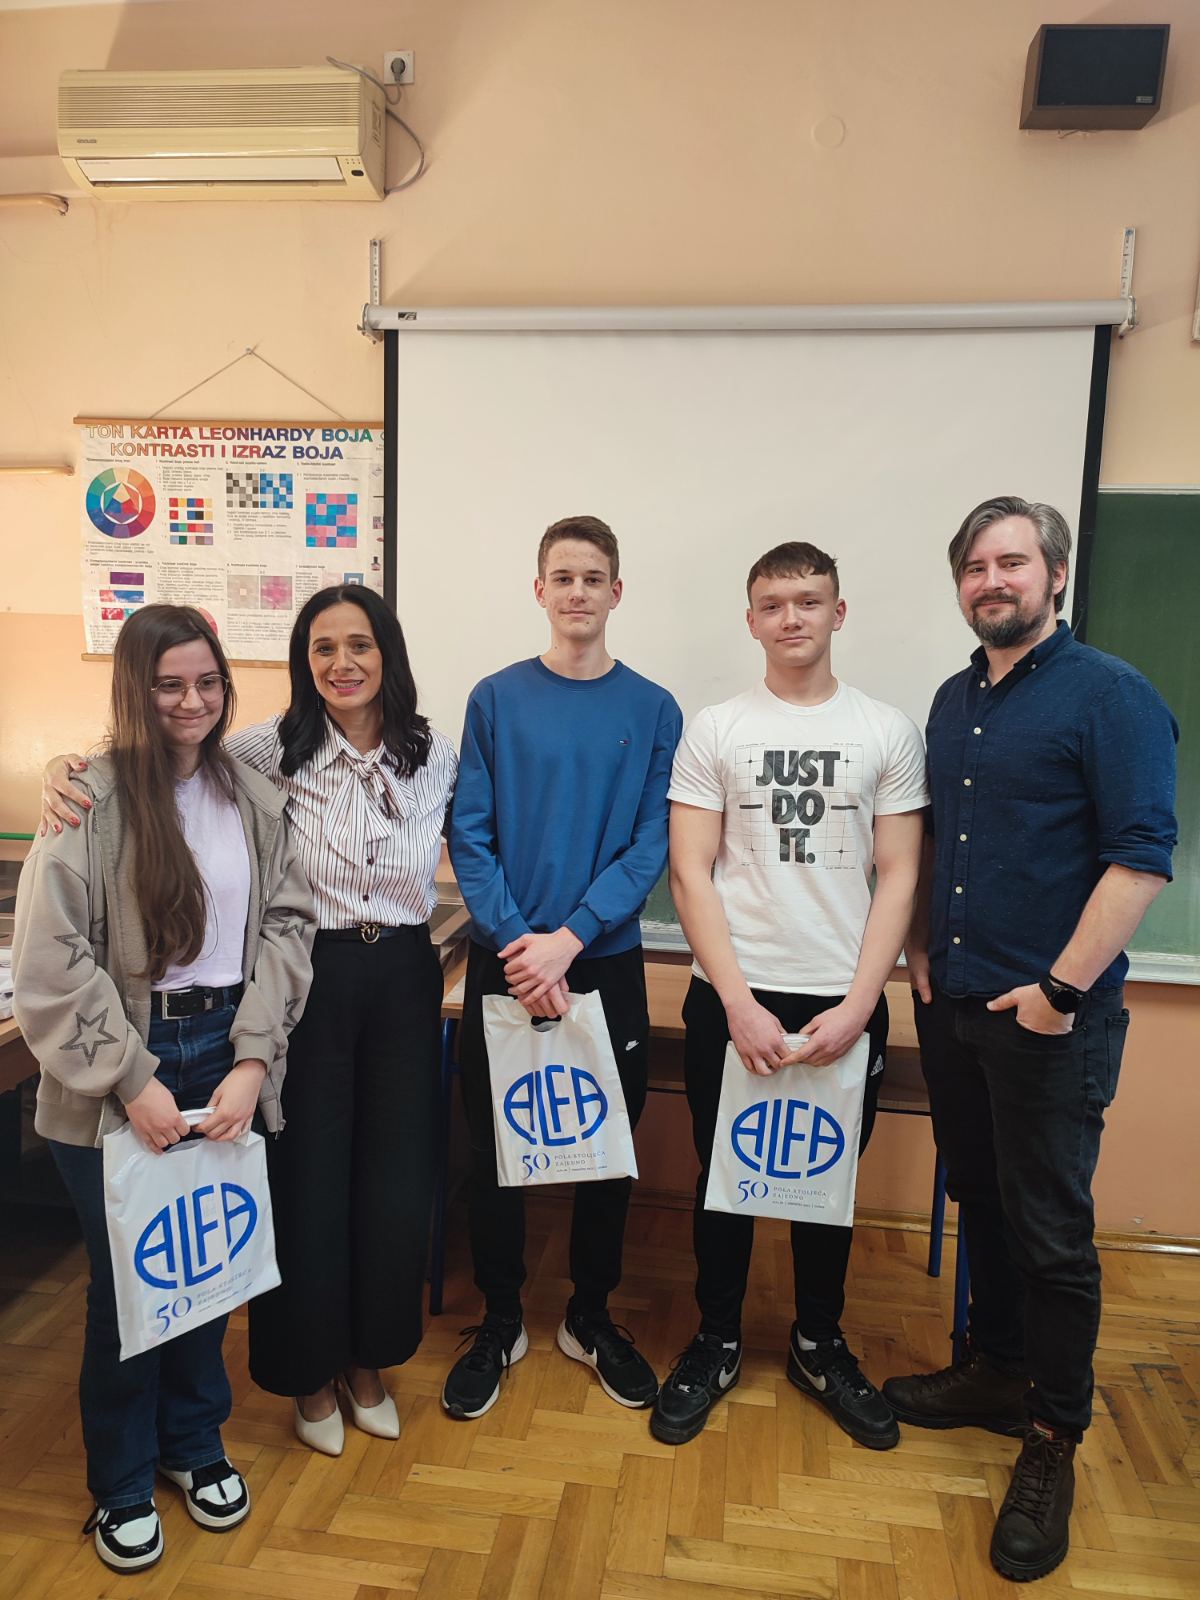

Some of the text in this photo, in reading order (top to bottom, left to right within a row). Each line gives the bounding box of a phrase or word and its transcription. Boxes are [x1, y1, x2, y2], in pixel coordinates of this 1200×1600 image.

[86, 424, 373, 443] TON KARTA LEONHARDY BOJA
[110, 442, 344, 460] KONTRASTI I IZRAZ BOJA
[756, 750, 840, 787] JUST
[772, 788, 825, 826] DO
[779, 828, 816, 864] IT.
[503, 1064, 608, 1147] ALFA
[731, 1098, 845, 1179] ALFA
[522, 1152, 550, 1179] 50
[736, 1179, 768, 1205] 50
[134, 1182, 258, 1290] ALFA
[156, 1296, 192, 1337] 50
